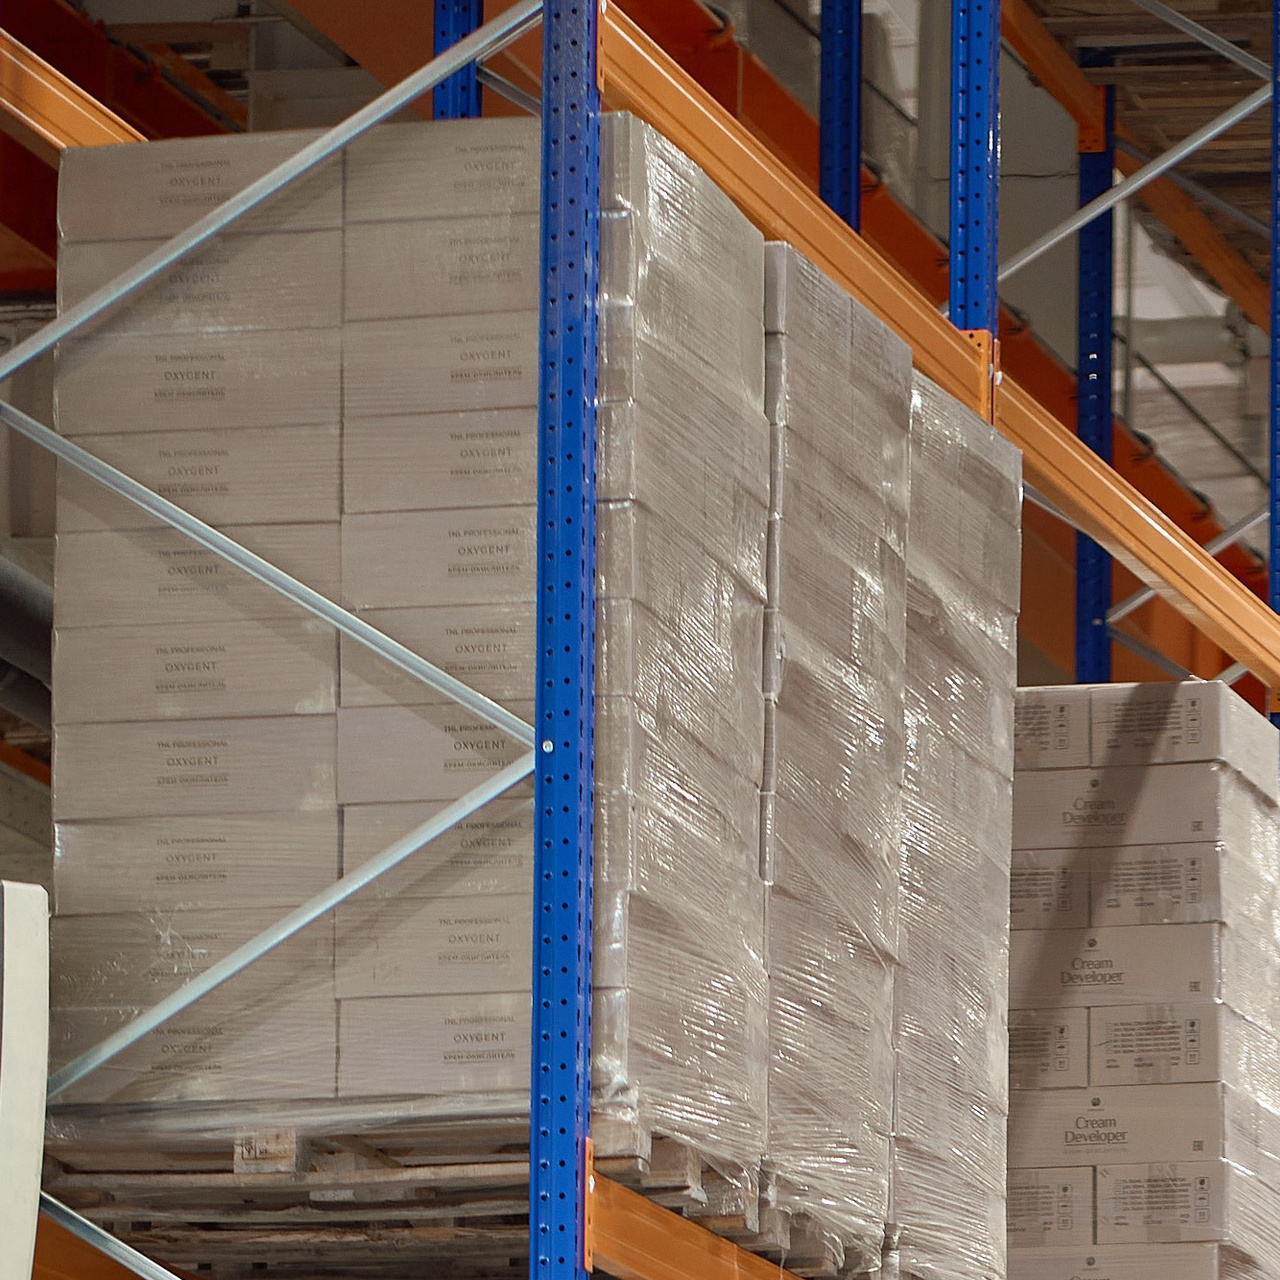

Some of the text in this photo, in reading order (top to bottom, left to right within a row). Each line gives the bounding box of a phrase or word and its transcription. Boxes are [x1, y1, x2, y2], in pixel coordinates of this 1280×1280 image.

[460, 446, 511, 458] OXYGENT
[458, 544, 509, 556] OXYGENT
[455, 643, 506, 654] OXYGENT
[453, 740, 506, 751] OXYGENT
[167, 756, 219, 767] OXYGENT
[1072, 797, 1116, 811] Cream
[1061, 811, 1126, 826] Developer
[459, 838, 511, 850] OXYGENT
[448, 933, 500, 944] OXYGENT
[1070, 957, 1113, 970] Cream
[1060, 971, 1125, 985] Developer
[452, 1032, 506, 1043] OXYGENT
[1074, 1116, 1117, 1130] Cream
[1063, 1130, 1128, 1144] Developer
